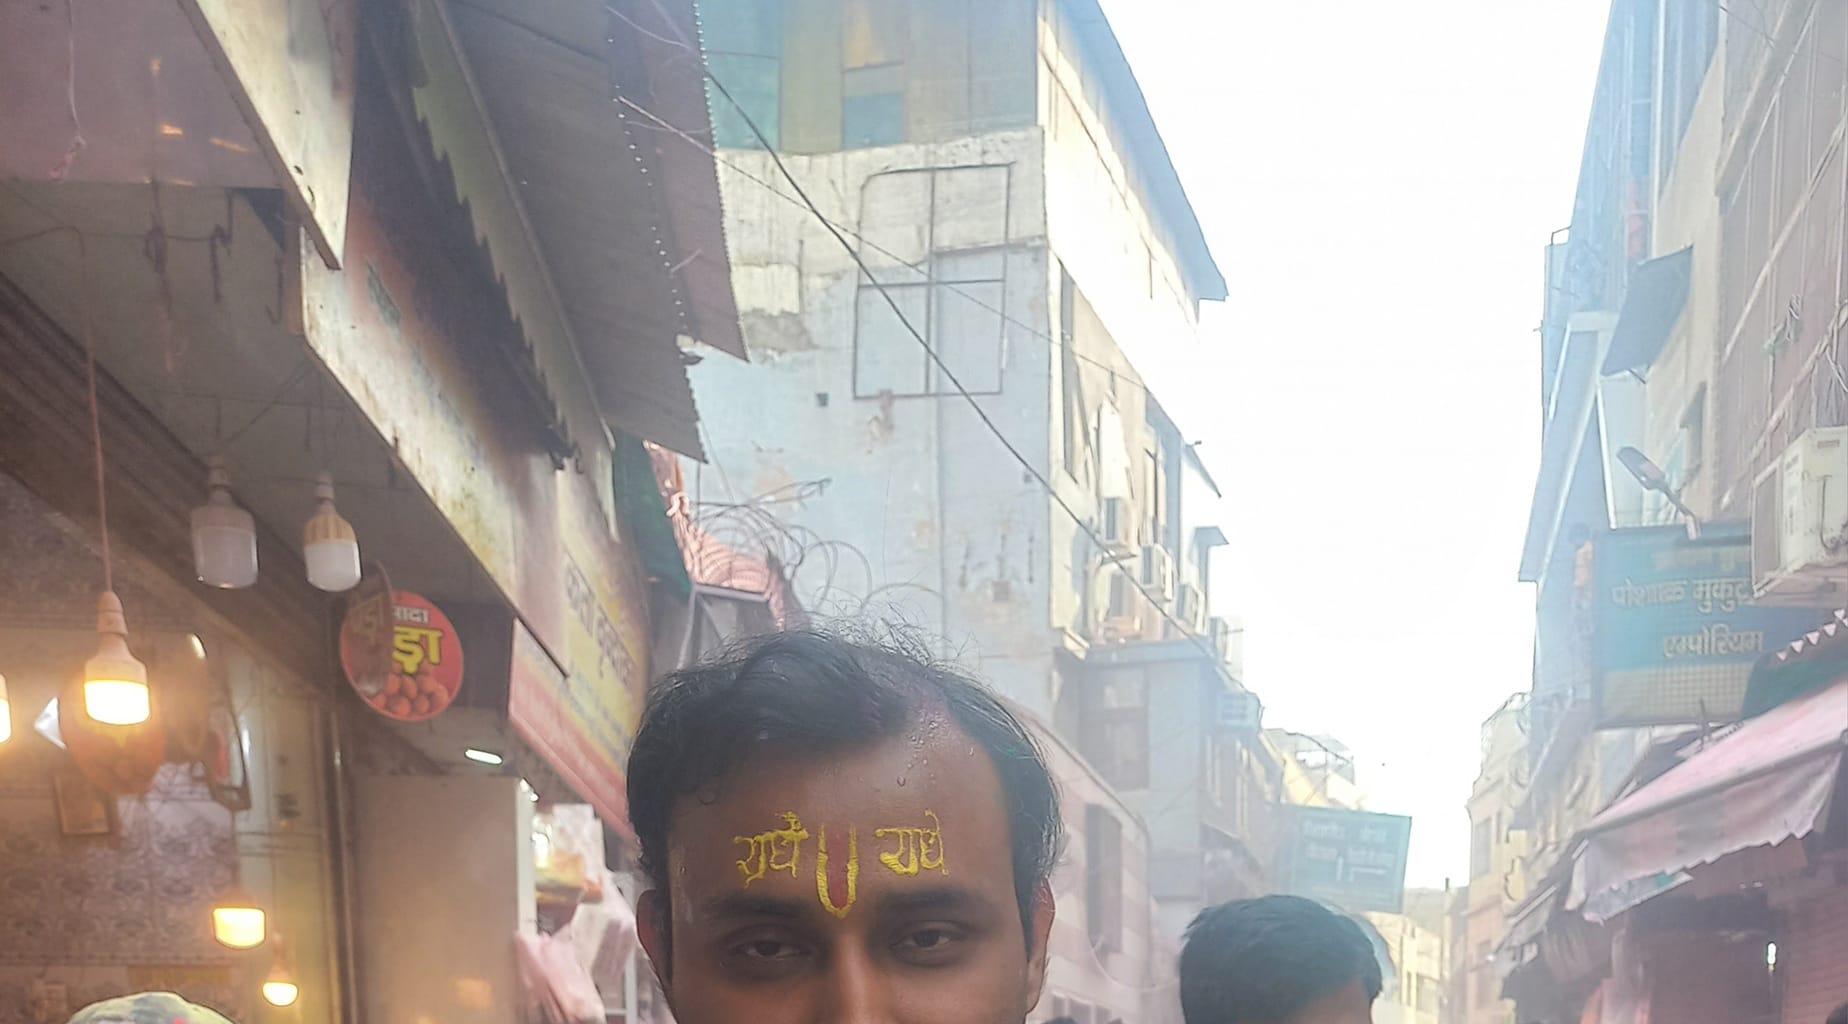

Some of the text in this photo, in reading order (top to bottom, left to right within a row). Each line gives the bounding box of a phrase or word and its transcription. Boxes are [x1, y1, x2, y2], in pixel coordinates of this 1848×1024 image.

[392, 625, 443, 676] ड़ा
[734, 808, 949, 889] राधे राधे
